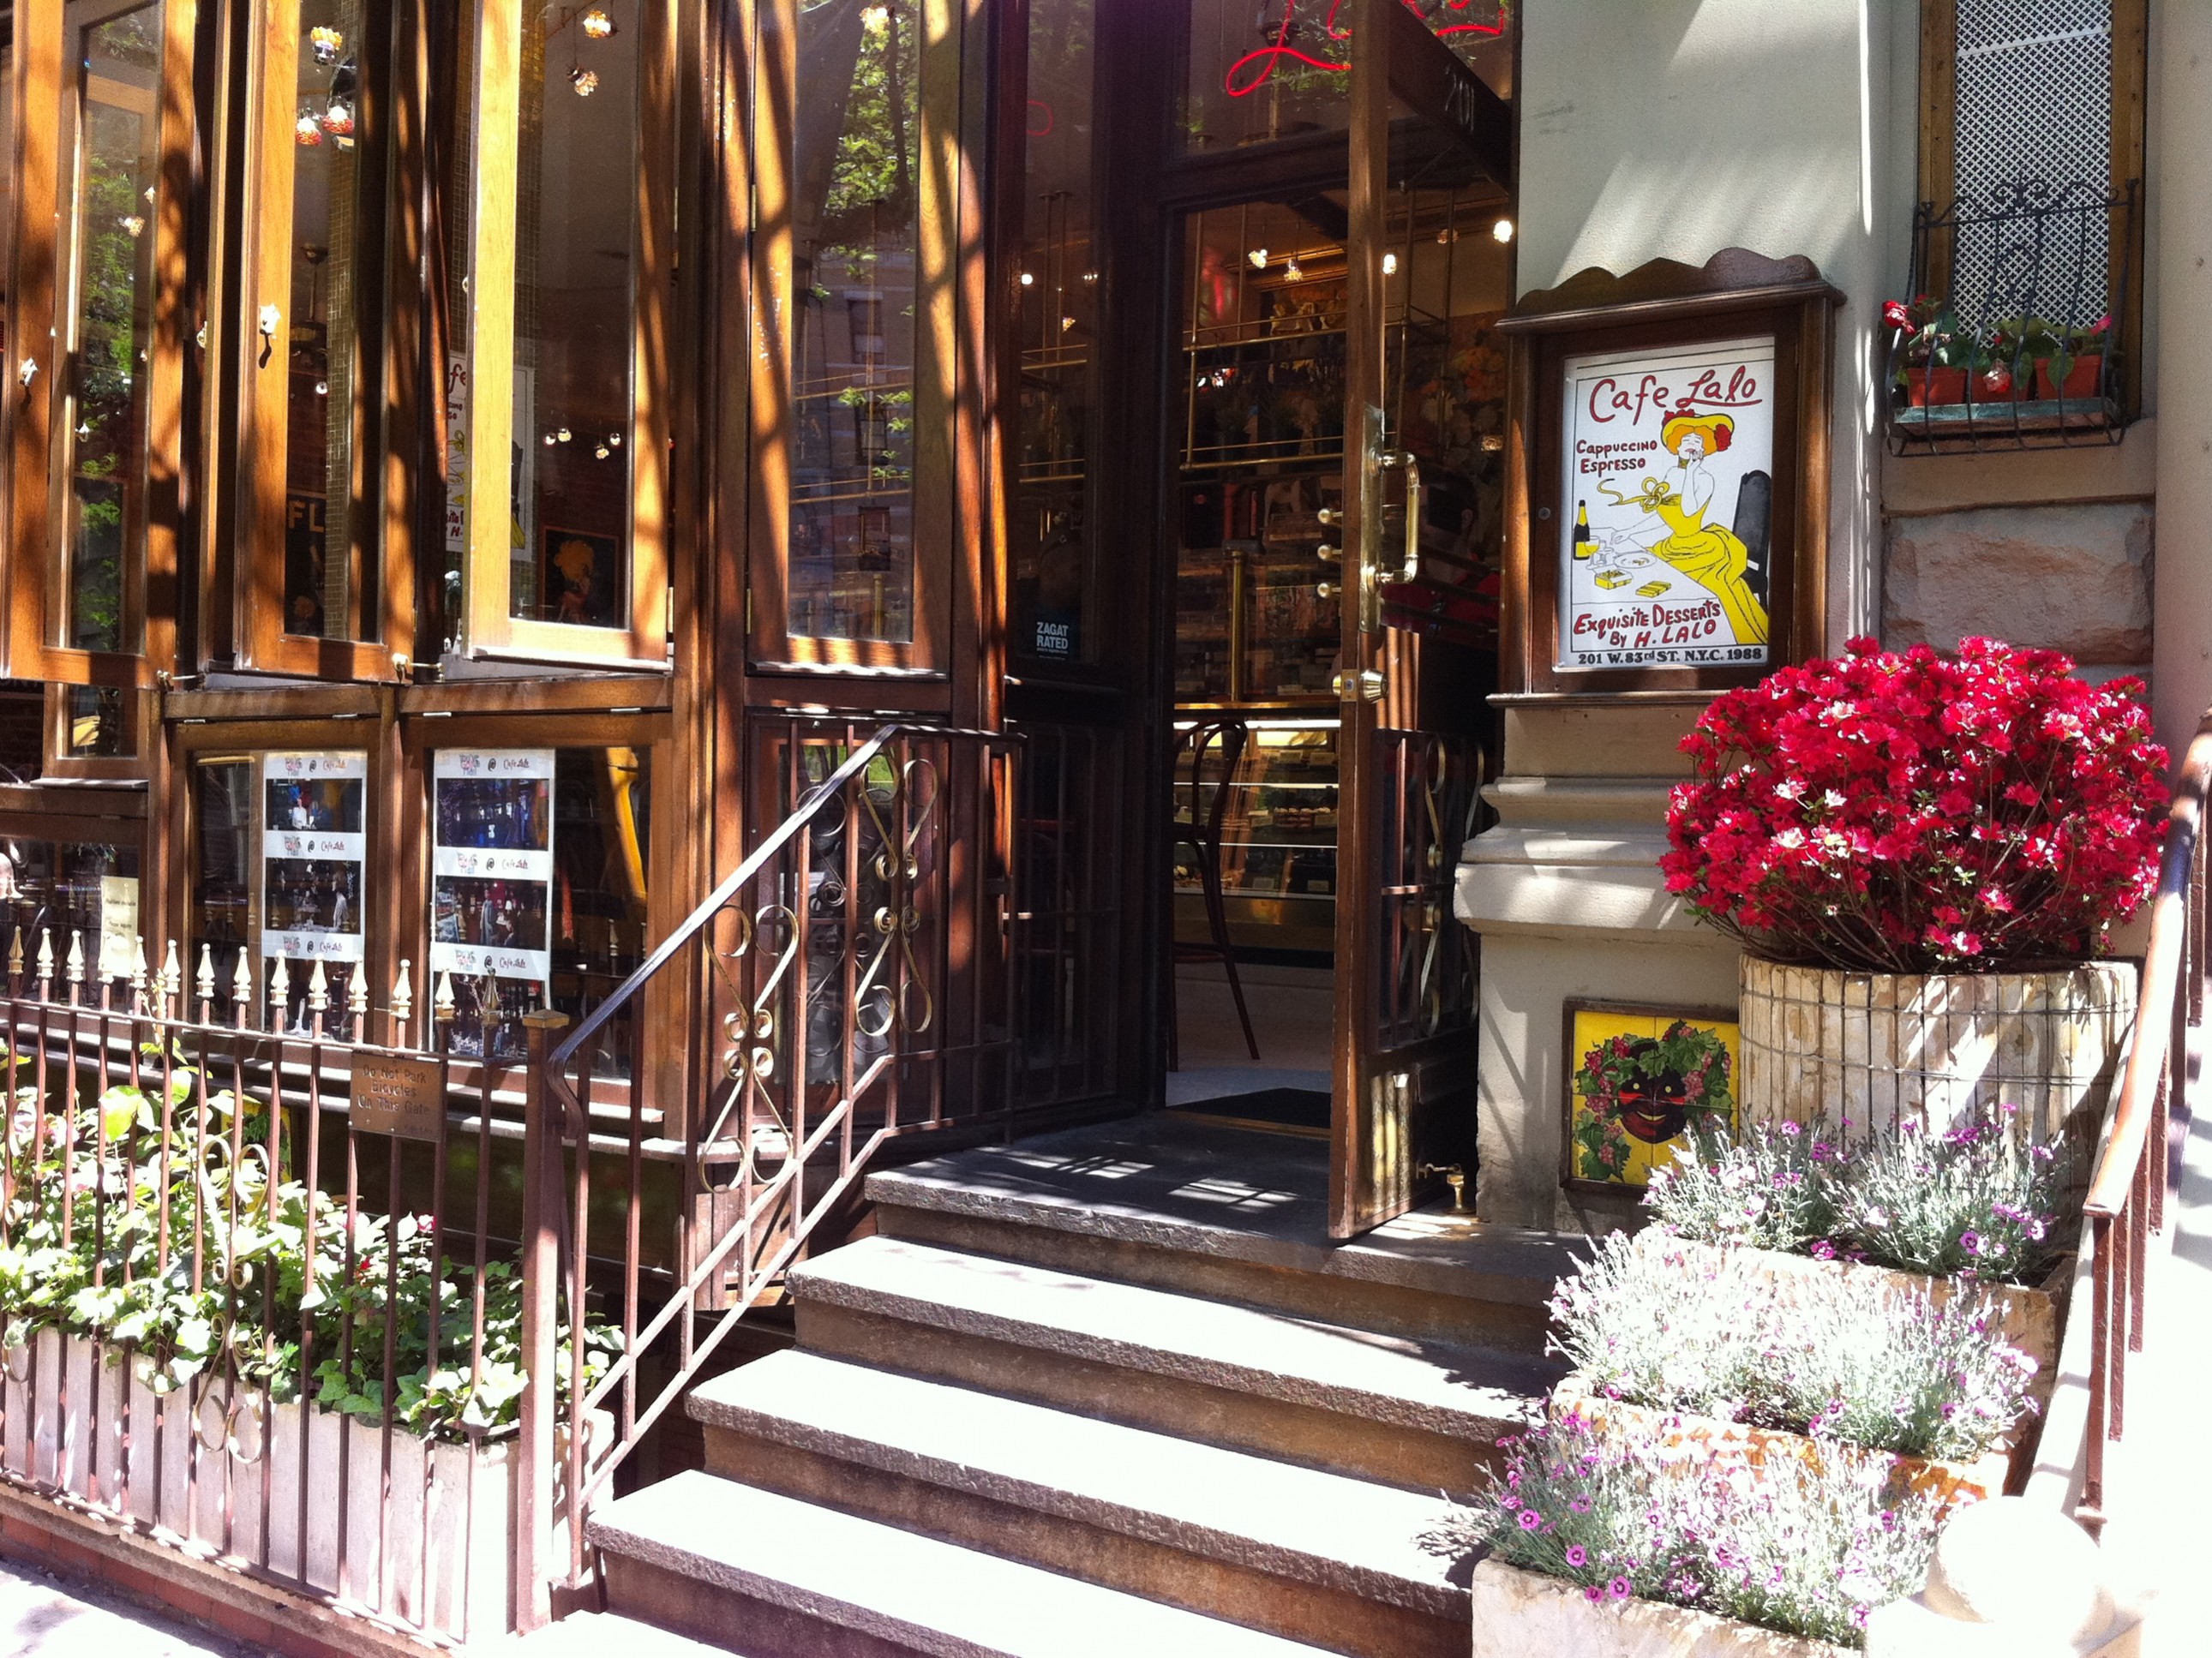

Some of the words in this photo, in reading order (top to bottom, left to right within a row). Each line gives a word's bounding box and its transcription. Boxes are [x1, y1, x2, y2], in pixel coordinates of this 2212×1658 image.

[1589, 375, 1669, 426] Cafe
[1675, 365, 1762, 409] Lalo
[1037, 621, 1069, 637] ZAGAT
[1634, 631, 1658, 649] H.
[1663, 619, 1717, 644] LALO
[1037, 635, 1069, 649] RATED
[1578, 652, 1604, 665] 201
[1607, 650, 1624, 664] W.
[1657, 649, 1681, 662] ST.
[1683, 648, 1724, 661] N.Y.C.
[1727, 648, 1763, 661] 1988
[363, 1064, 376, 1078] Do
[381, 1067, 399, 1080] Not
[404, 1068, 426, 1084] Park
[371, 1080, 417, 1098] Bicycles
[357, 1094, 373, 1110] On
[377, 1097, 399, 1112] This
